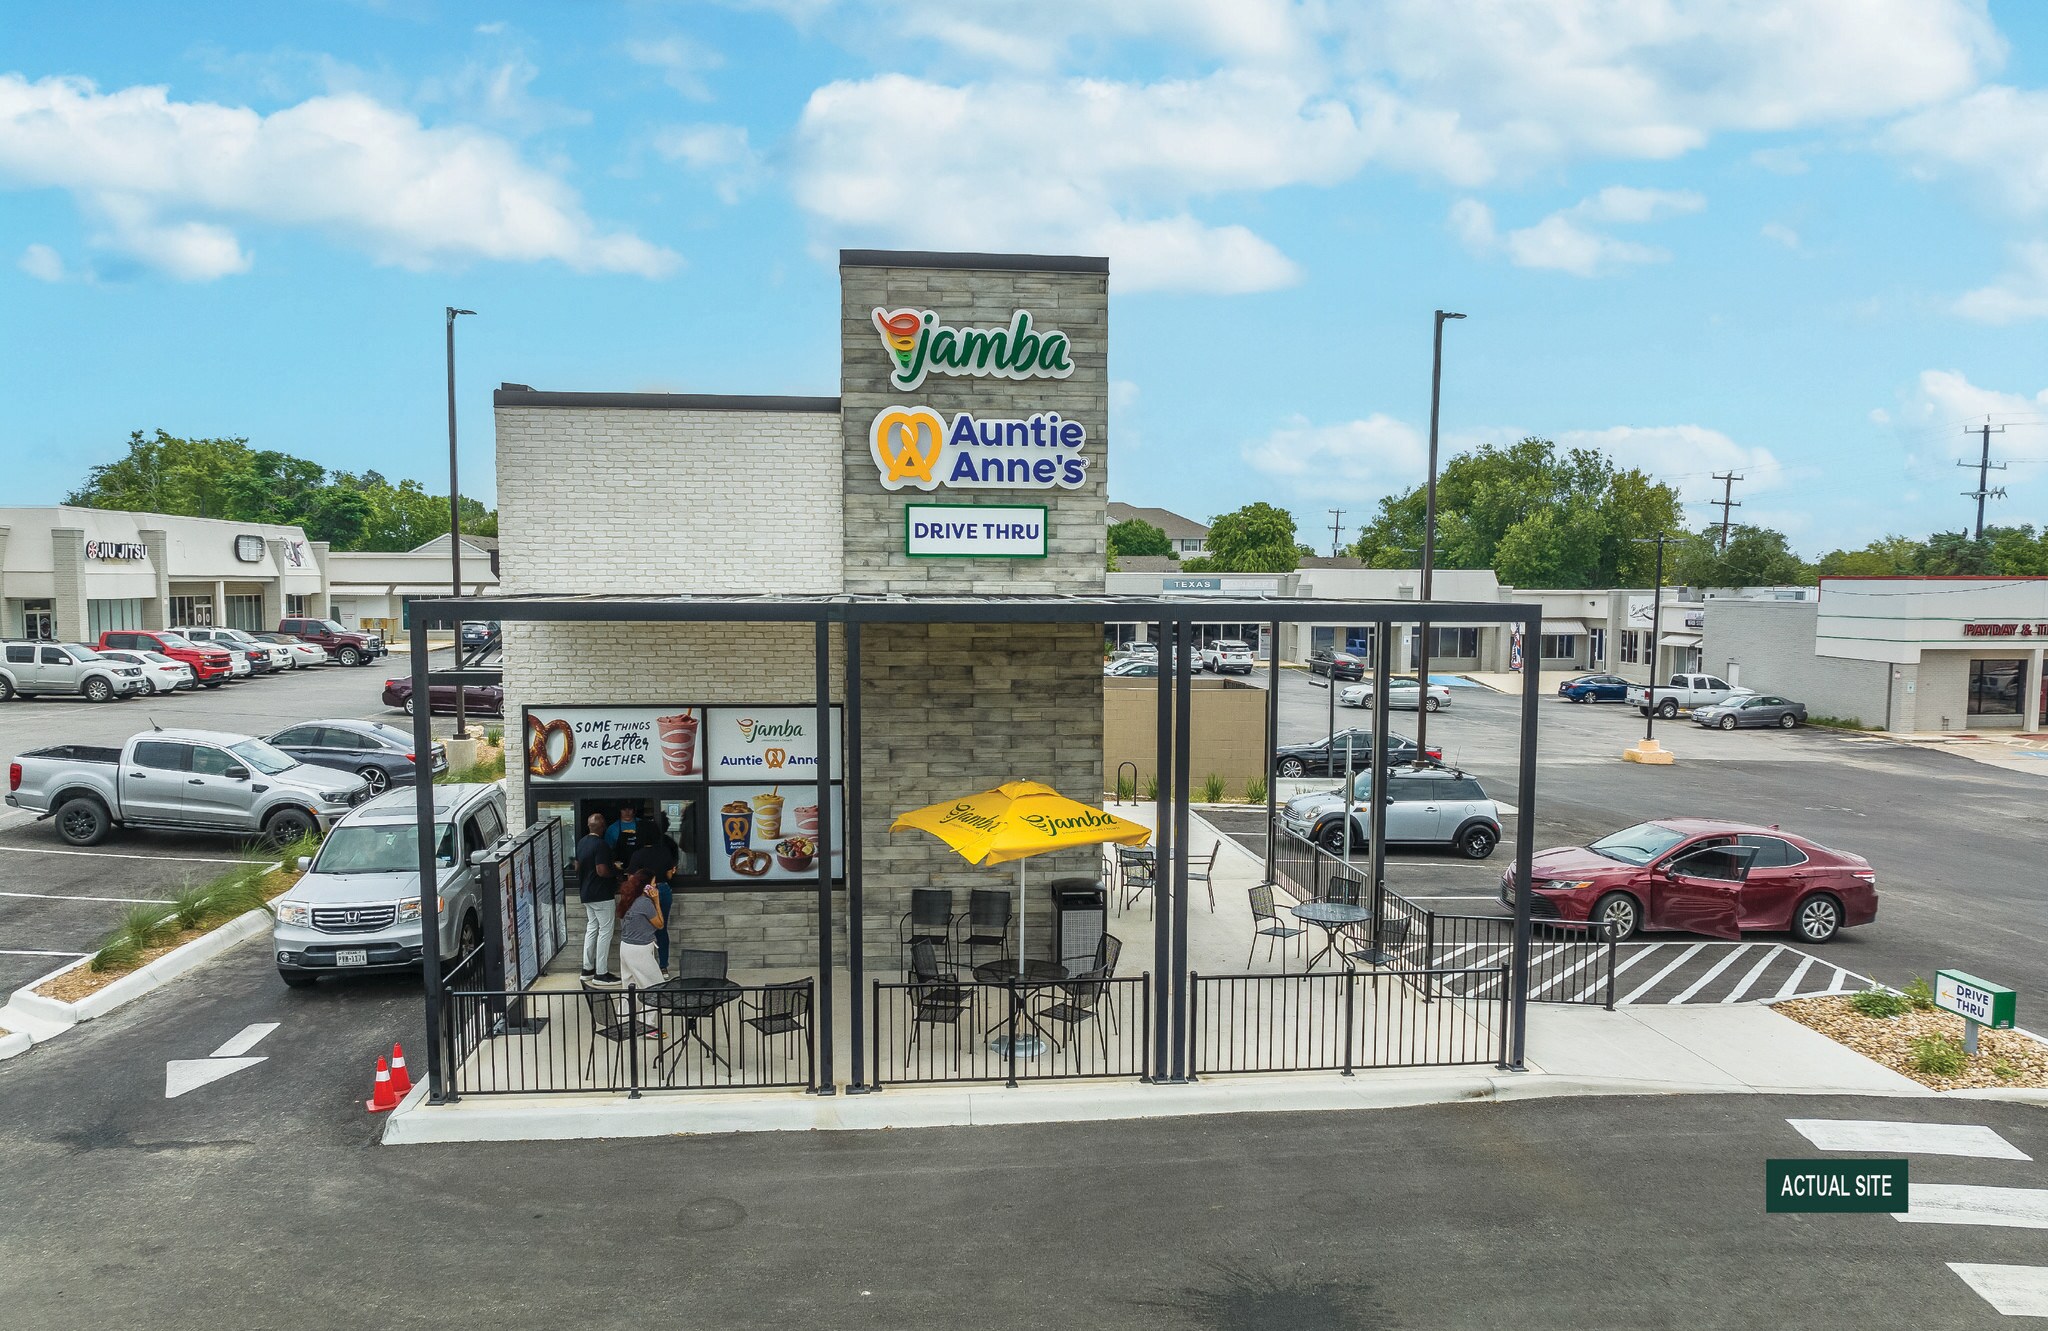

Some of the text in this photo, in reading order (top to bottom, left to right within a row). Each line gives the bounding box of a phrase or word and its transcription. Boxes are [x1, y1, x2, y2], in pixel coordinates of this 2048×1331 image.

[897, 313, 1071, 383] jamba
[950, 415, 1084, 448] Auntie
[914, 522, 1040, 540] DRIVE THRU
[98, 542, 148, 559] JIU JITSU
[1964, 624, 2019, 636] PAYDAY
[2021, 624, 2032, 636] &
[575, 720, 651, 733] SOME THINGS
[746, 719, 804, 743] jamba
[580, 732, 650, 751] ARE better
[581, 754, 647, 767] TOGETHER
[720, 755, 818, 766] Auntie Anne
[1046, 810, 1118, 837] jamba
[1956, 984, 1990, 1006] DRIVE
[1956, 998, 1985, 1018] THRU
